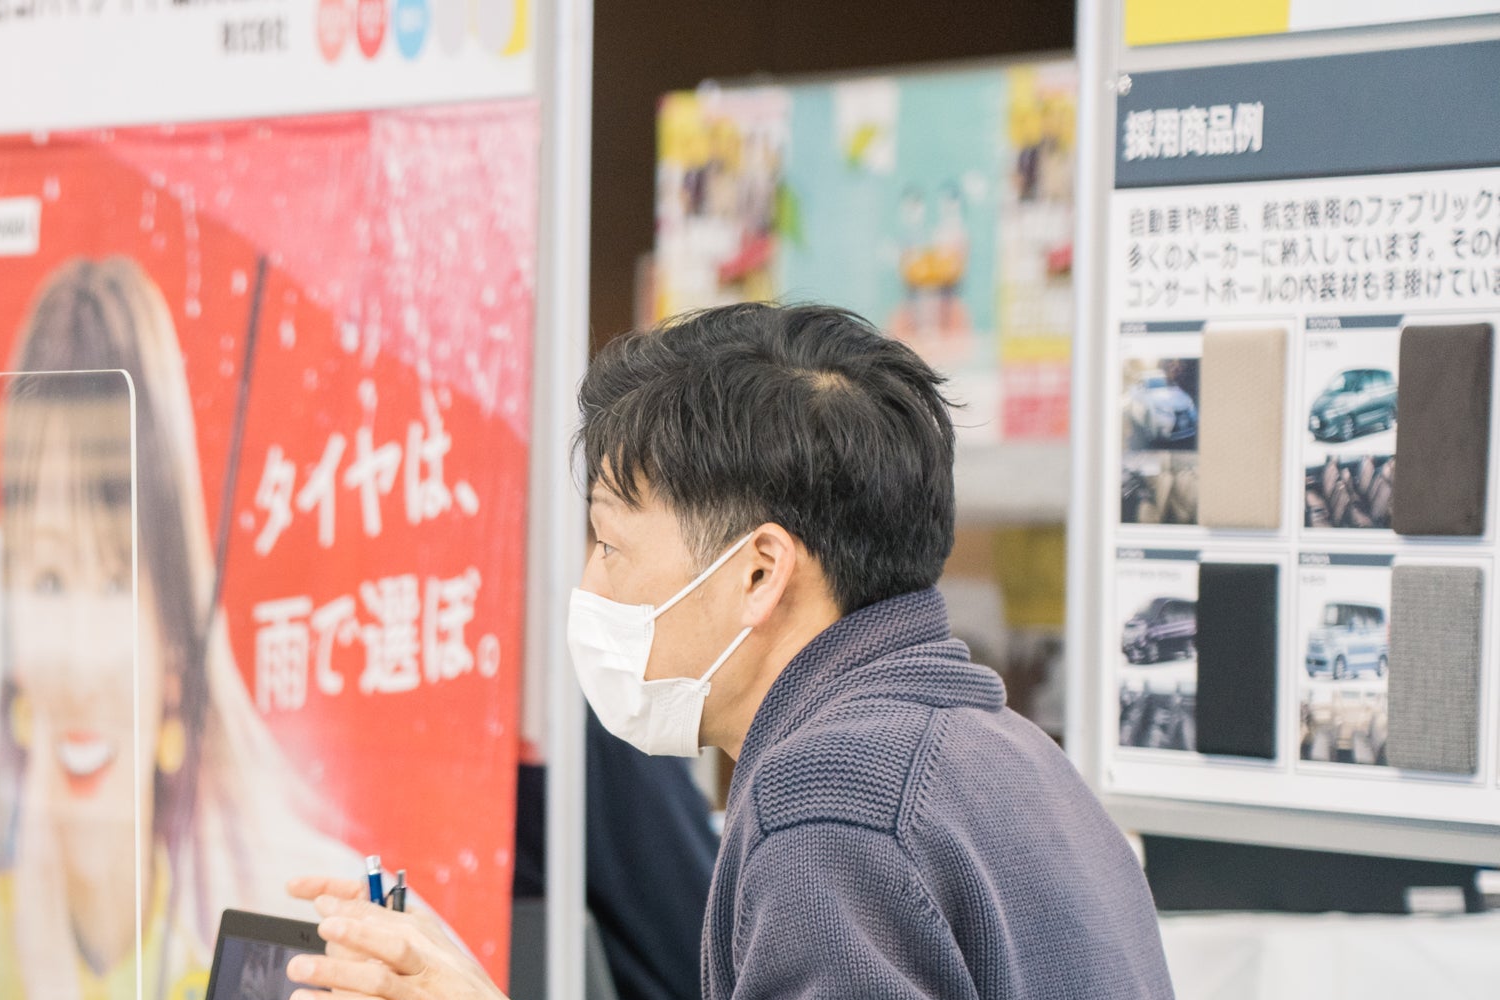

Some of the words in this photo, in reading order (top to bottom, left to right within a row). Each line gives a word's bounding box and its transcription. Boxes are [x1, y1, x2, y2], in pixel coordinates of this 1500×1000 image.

[1123, 100, 1265, 162] 採用商品例
[1129, 189, 1500, 237] 自動車や鉄道、航空機用のファブリック
[254, 420, 479, 556] タイヤは、
[252, 567, 500, 713] 雨で選ぼ。
